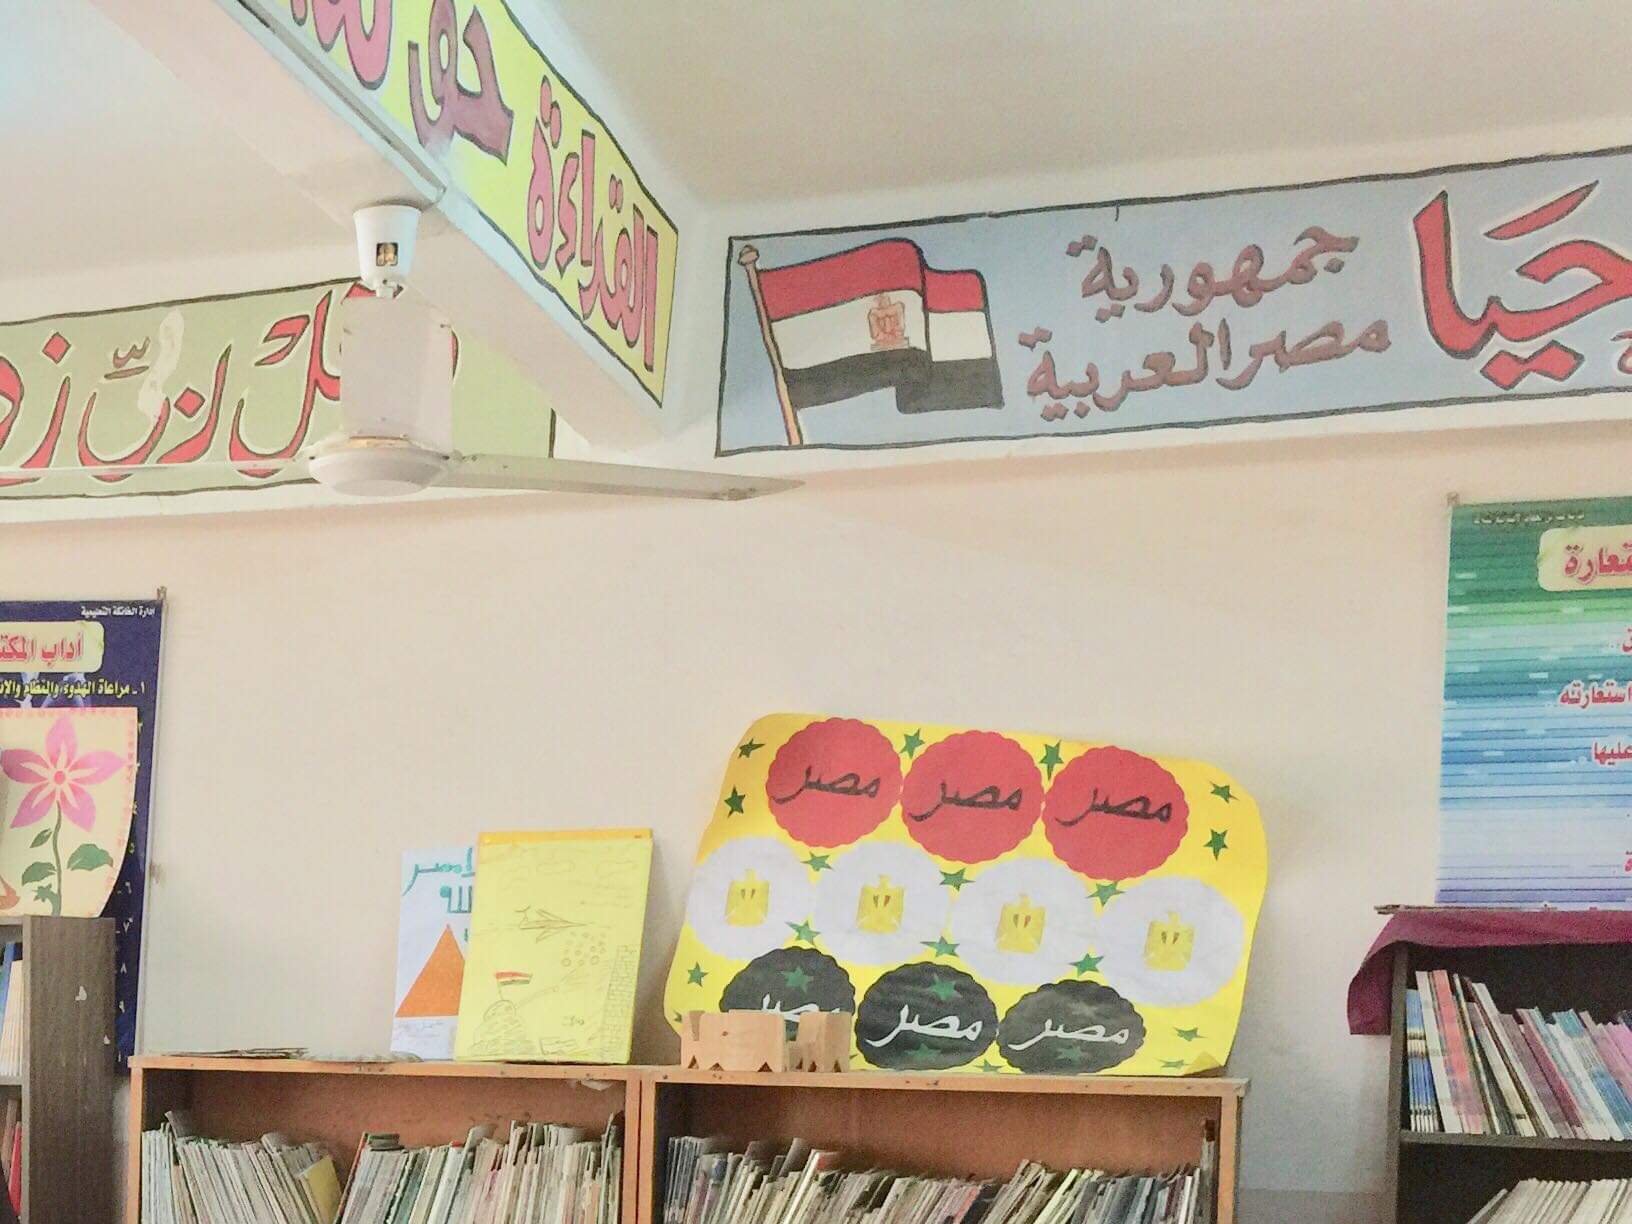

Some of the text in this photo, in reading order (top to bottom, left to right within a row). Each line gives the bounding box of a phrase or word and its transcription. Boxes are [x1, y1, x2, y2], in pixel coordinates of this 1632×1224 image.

[1065, 225, 1360, 324] جمهورية
[1018, 317, 1392, 422] مصر العربية
[770, 764, 882, 805] مصر
[908, 779, 1023, 822] مصر
[1054, 786, 1174, 827] مصر
[865, 1003, 984, 1049] مصر
[1006, 1017, 1131, 1052] مصر
